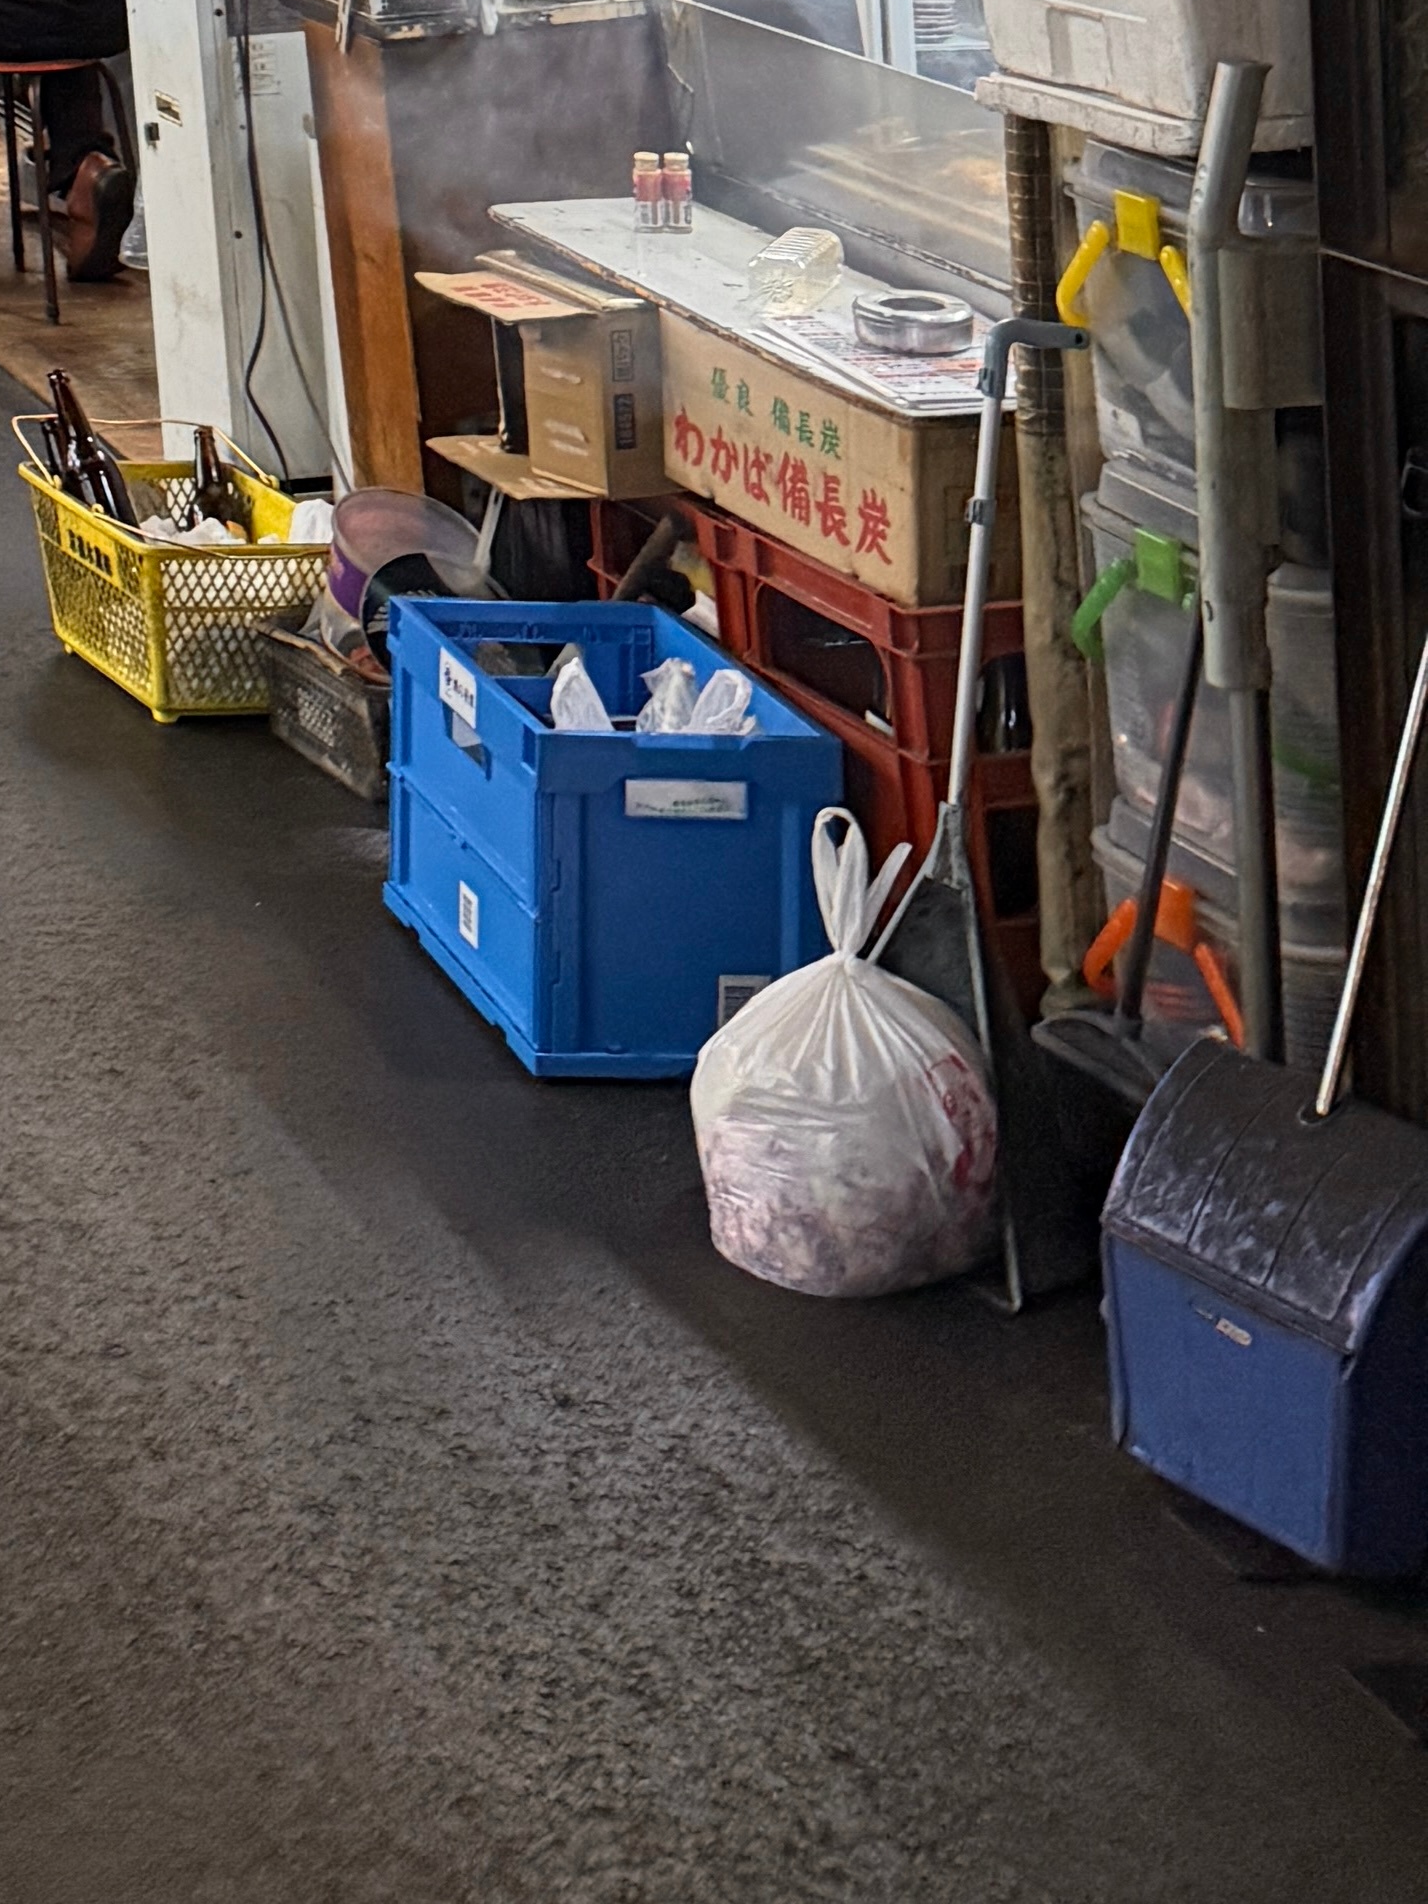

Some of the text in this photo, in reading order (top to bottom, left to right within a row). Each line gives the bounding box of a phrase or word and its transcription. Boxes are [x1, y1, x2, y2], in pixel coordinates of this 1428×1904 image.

[711, 367, 842, 460] 優良 備長炭
[674, 403, 893, 566] わかば備長炭
